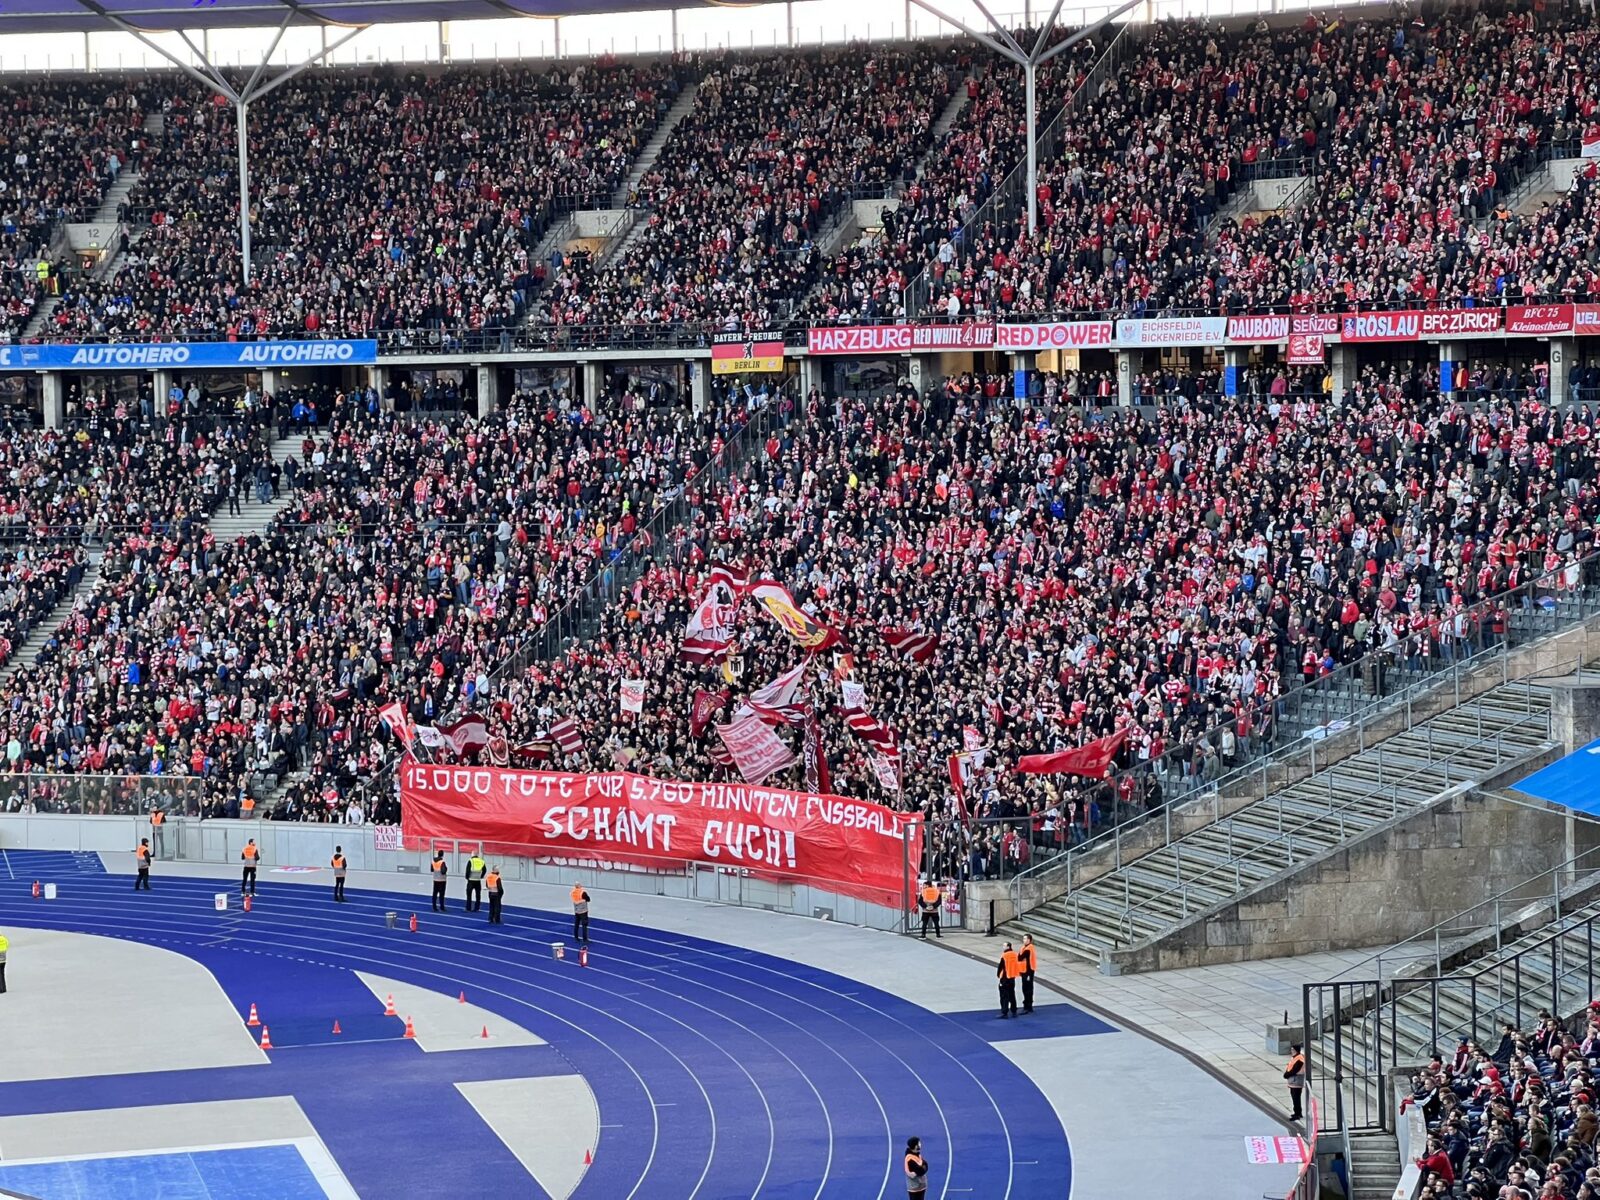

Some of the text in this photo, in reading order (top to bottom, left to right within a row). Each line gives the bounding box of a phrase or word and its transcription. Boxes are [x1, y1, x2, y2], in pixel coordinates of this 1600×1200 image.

[1276, 184, 1288, 195] 15
[597, 215, 608, 225] 13
[88, 228, 99, 238] 12
[1523, 307, 1560, 318] BFC 75
[1142, 321, 1202, 331] EICHSFELDIA
[1229, 315, 1289, 338] DAUBORN
[1356, 315, 1418, 338] RÖSLAU
[1423, 312, 1498, 331] BFC ZÜRICH
[1510, 320, 1569, 332] Kleinostheim
[809, 327, 911, 351] HARZBURG
[913, 325, 993, 346] RED WHITE 4 LIFE
[1000, 323, 1112, 347] RED POWER
[1141, 332, 1221, 342] BICKENRIEDE E.V.
[72, 346, 190, 364] AUTOHERO
[238, 343, 353, 362] AUTOHERO
[1552, 350, 1561, 362] G
[734, 360, 760, 369] BERLIN
[911, 365, 919, 375] G
[1120, 361, 1128, 372] G
[406, 767, 491, 794] 15.000
[499, 773, 573, 798] TOTE
[630, 777, 694, 803] 5.760
[700, 785, 799, 817] MINUTEN
[542, 806, 677, 851] SCHÄMT
[703, 820, 796, 868] EUCH!
